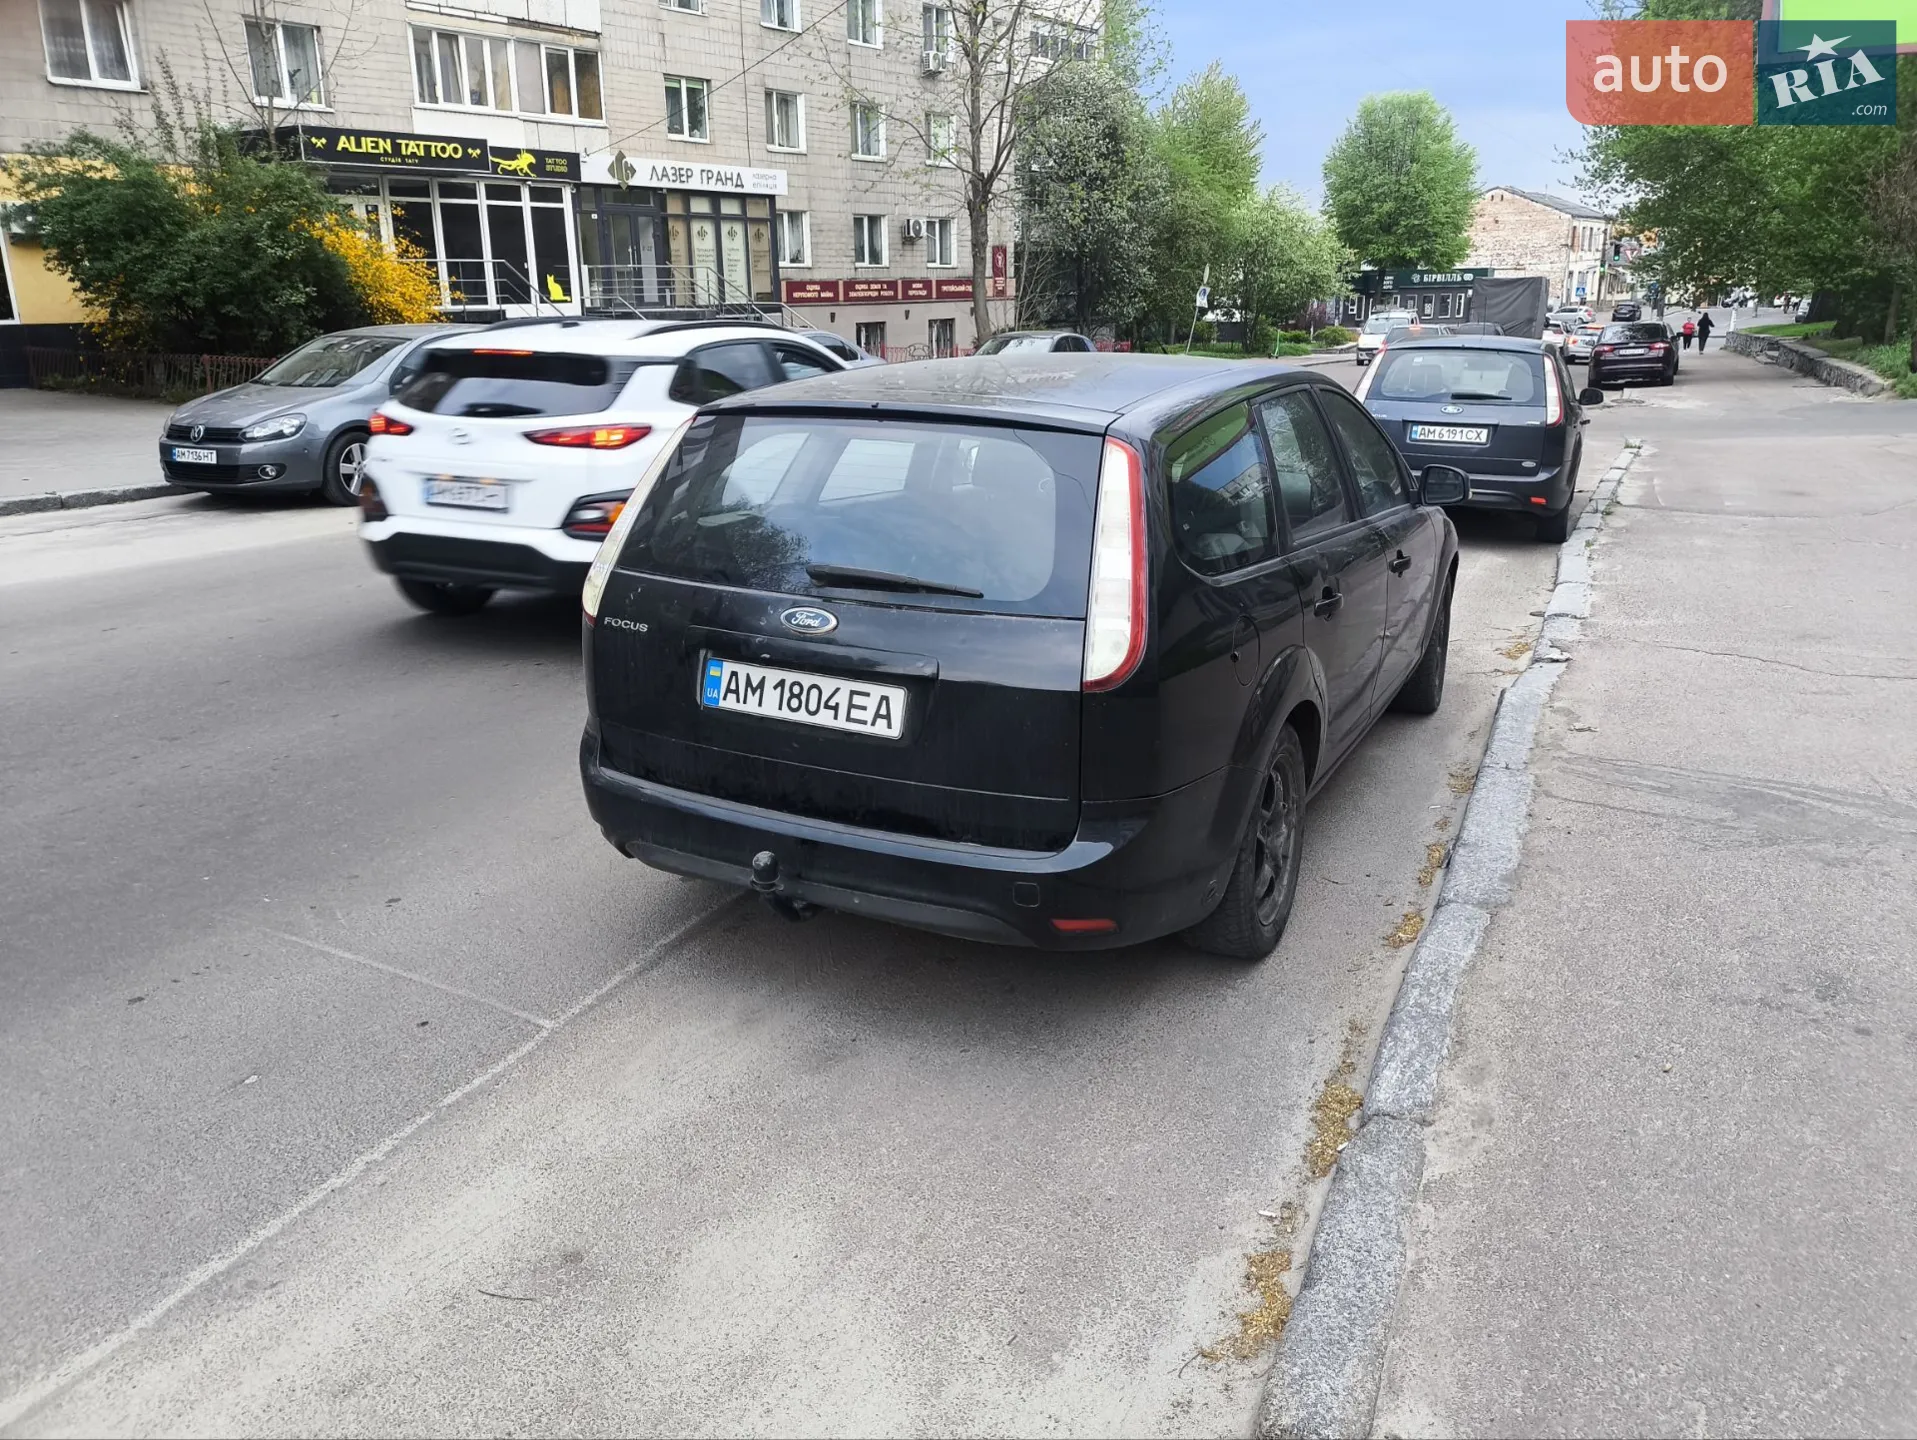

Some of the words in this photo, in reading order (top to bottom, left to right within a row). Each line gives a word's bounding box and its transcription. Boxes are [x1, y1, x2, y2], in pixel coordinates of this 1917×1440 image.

[336, 135, 392, 154] ALIEN
[396, 139, 463, 159] TATTOO
[545, 157, 568, 166] TATTOO
[545, 164, 568, 173] STUDIO
[649, 165, 694, 184] ЛАЗЕР
[700, 169, 745, 189] ГРАНД
[1423, 273, 1462, 282] БІРВІЛЛЬ
[604, 616, 648, 632] FOCUS
[791, 611, 822, 627] Ford
[706, 687, 719, 699] UA
